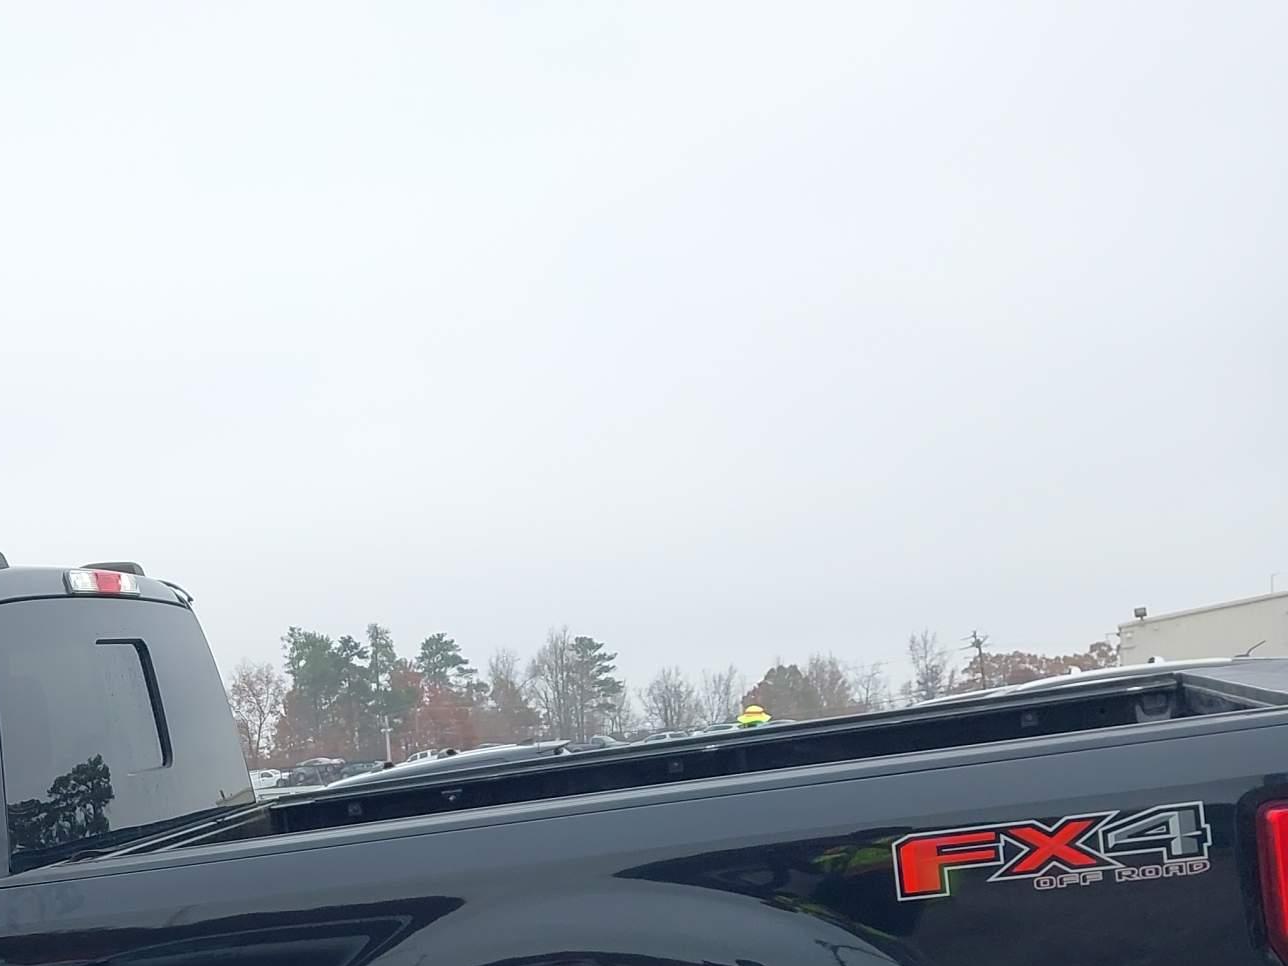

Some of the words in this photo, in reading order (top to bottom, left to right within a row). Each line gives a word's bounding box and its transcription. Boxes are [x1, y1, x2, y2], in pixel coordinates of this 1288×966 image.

[892, 801, 1212, 901] FX4
[1033, 871, 1103, 890] OFF
[1115, 861, 1210, 882] ROAD
